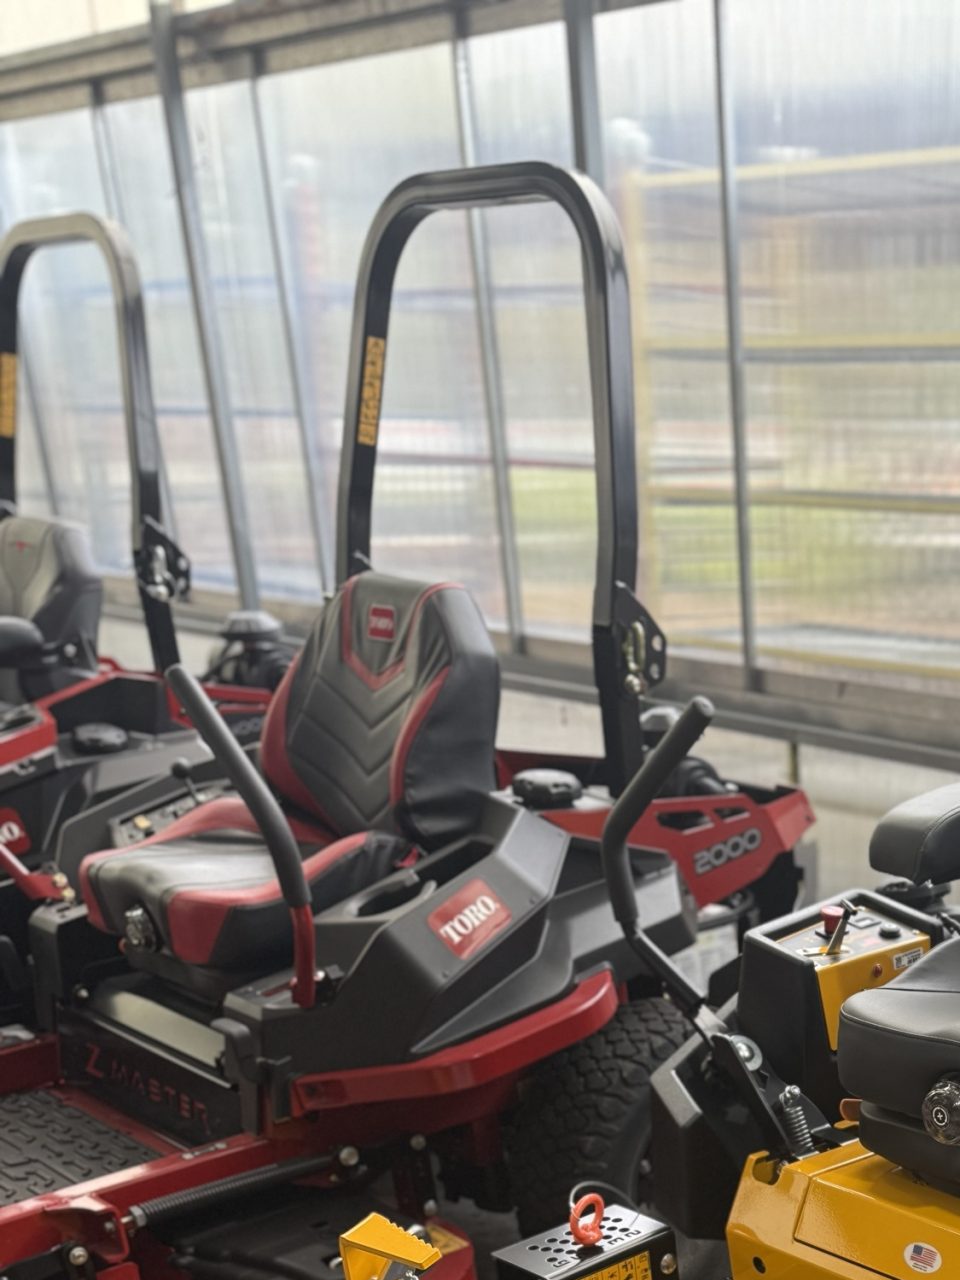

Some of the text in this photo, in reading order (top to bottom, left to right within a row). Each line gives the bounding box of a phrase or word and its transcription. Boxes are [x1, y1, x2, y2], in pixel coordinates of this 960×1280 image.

[693, 827, 762, 875] 2000
[439, 895, 497, 945] TORO
[86, 1041, 103, 1079] Z
